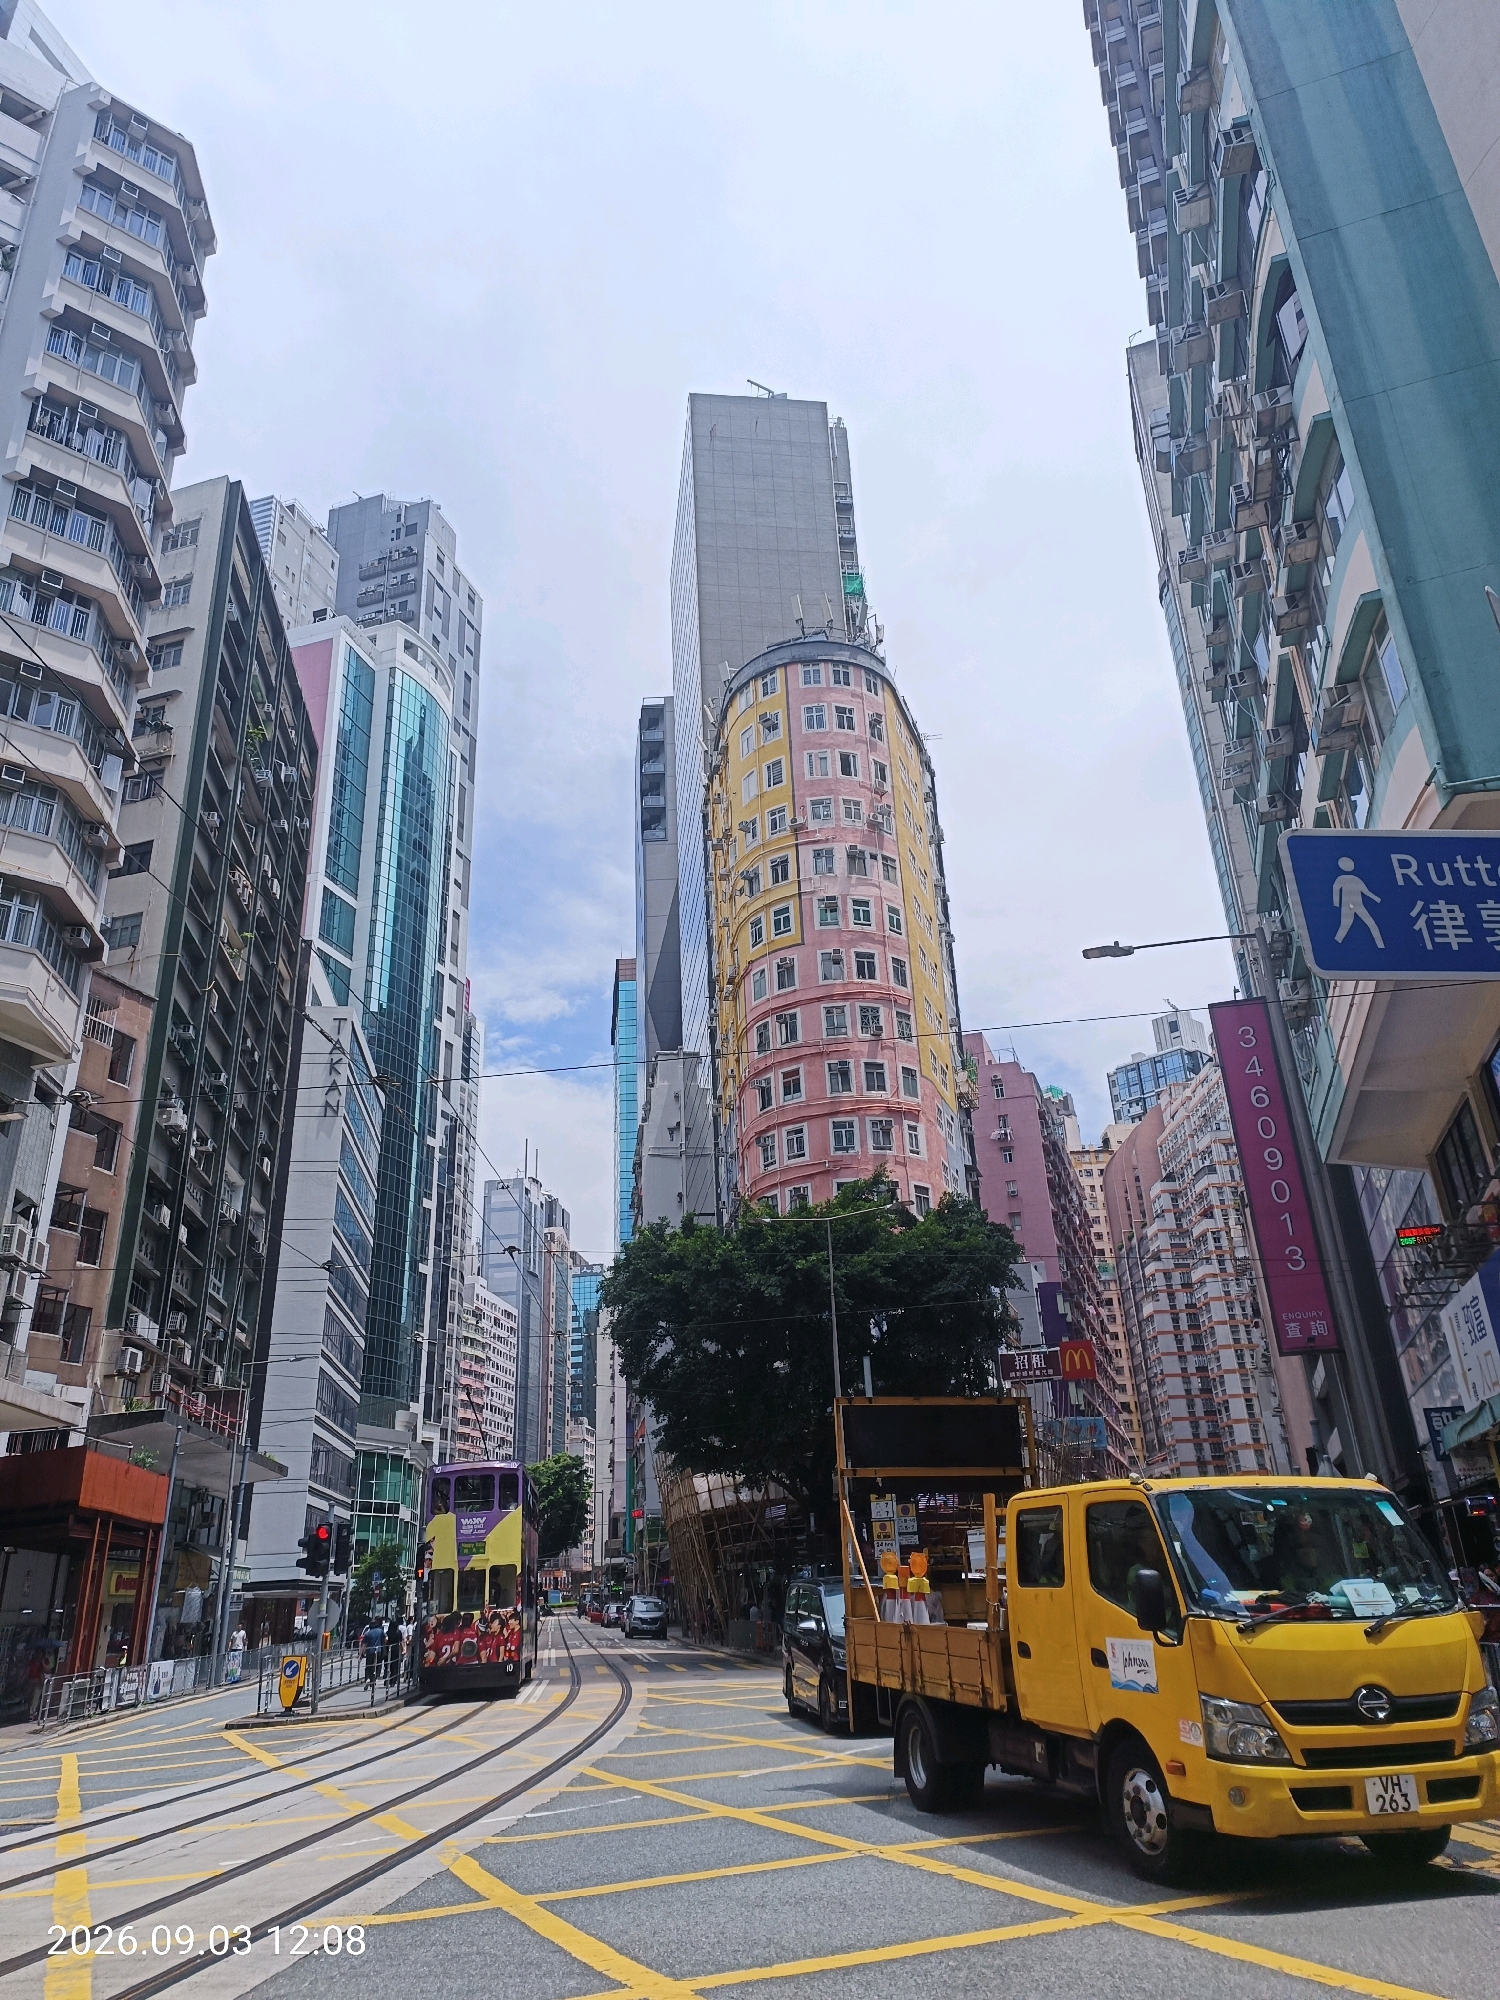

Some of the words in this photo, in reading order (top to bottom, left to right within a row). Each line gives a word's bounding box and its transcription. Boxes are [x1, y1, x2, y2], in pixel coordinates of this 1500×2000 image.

[1390, 853, 1500, 887] Rutt
[324, 1017, 348, 1117] TAKAN
[1237, 1026, 1306, 1271] 34609013
[1282, 1311, 1323, 1320] ENQUIRY
[1285, 1320, 1328, 1338] 查詢
[1014, 1354, 1047, 1370] 招租
[506, 1663, 513, 1672] 10
[1378, 1775, 1403, 1794] VH
[1375, 1793, 1411, 1813] 263
